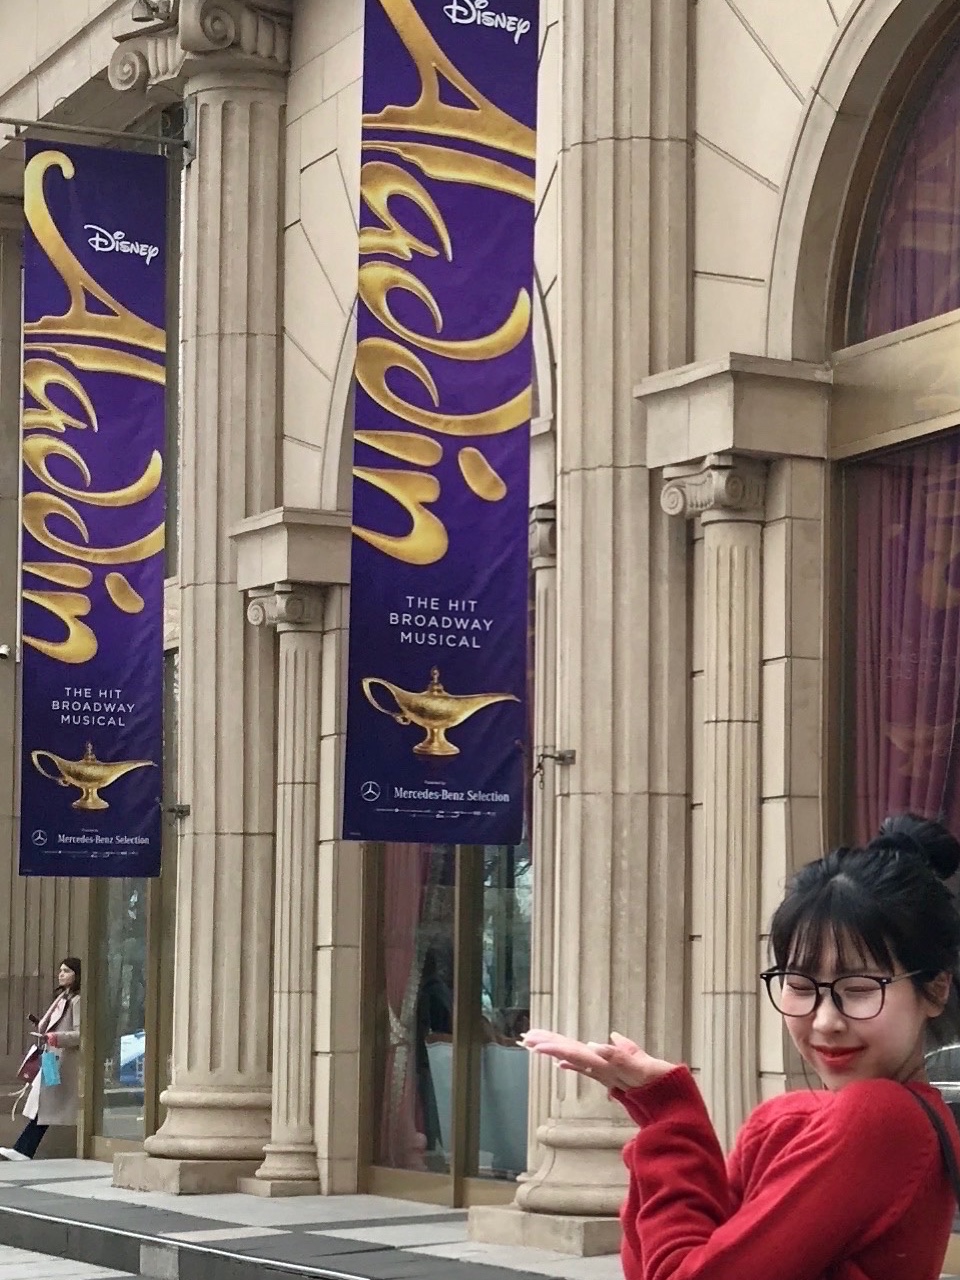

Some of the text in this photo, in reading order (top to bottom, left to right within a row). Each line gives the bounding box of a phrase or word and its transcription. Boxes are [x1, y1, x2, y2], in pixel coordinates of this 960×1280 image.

[443, 0, 531, 44] Disney
[83, 224, 159, 265] Disney
[405, 595, 477, 612] THE HIT
[389, 612, 493, 631] BROADWAY
[400, 631, 481, 649] MUSICAL
[64, 687, 122, 699] THE HIT
[51, 700, 135, 713] BROADWAY
[60, 714, 125, 727] MUSICAL
[394, 786, 510, 803] Mercedes-Benz Selection
[57, 833, 150, 845] Mercedes-Benz Selection
